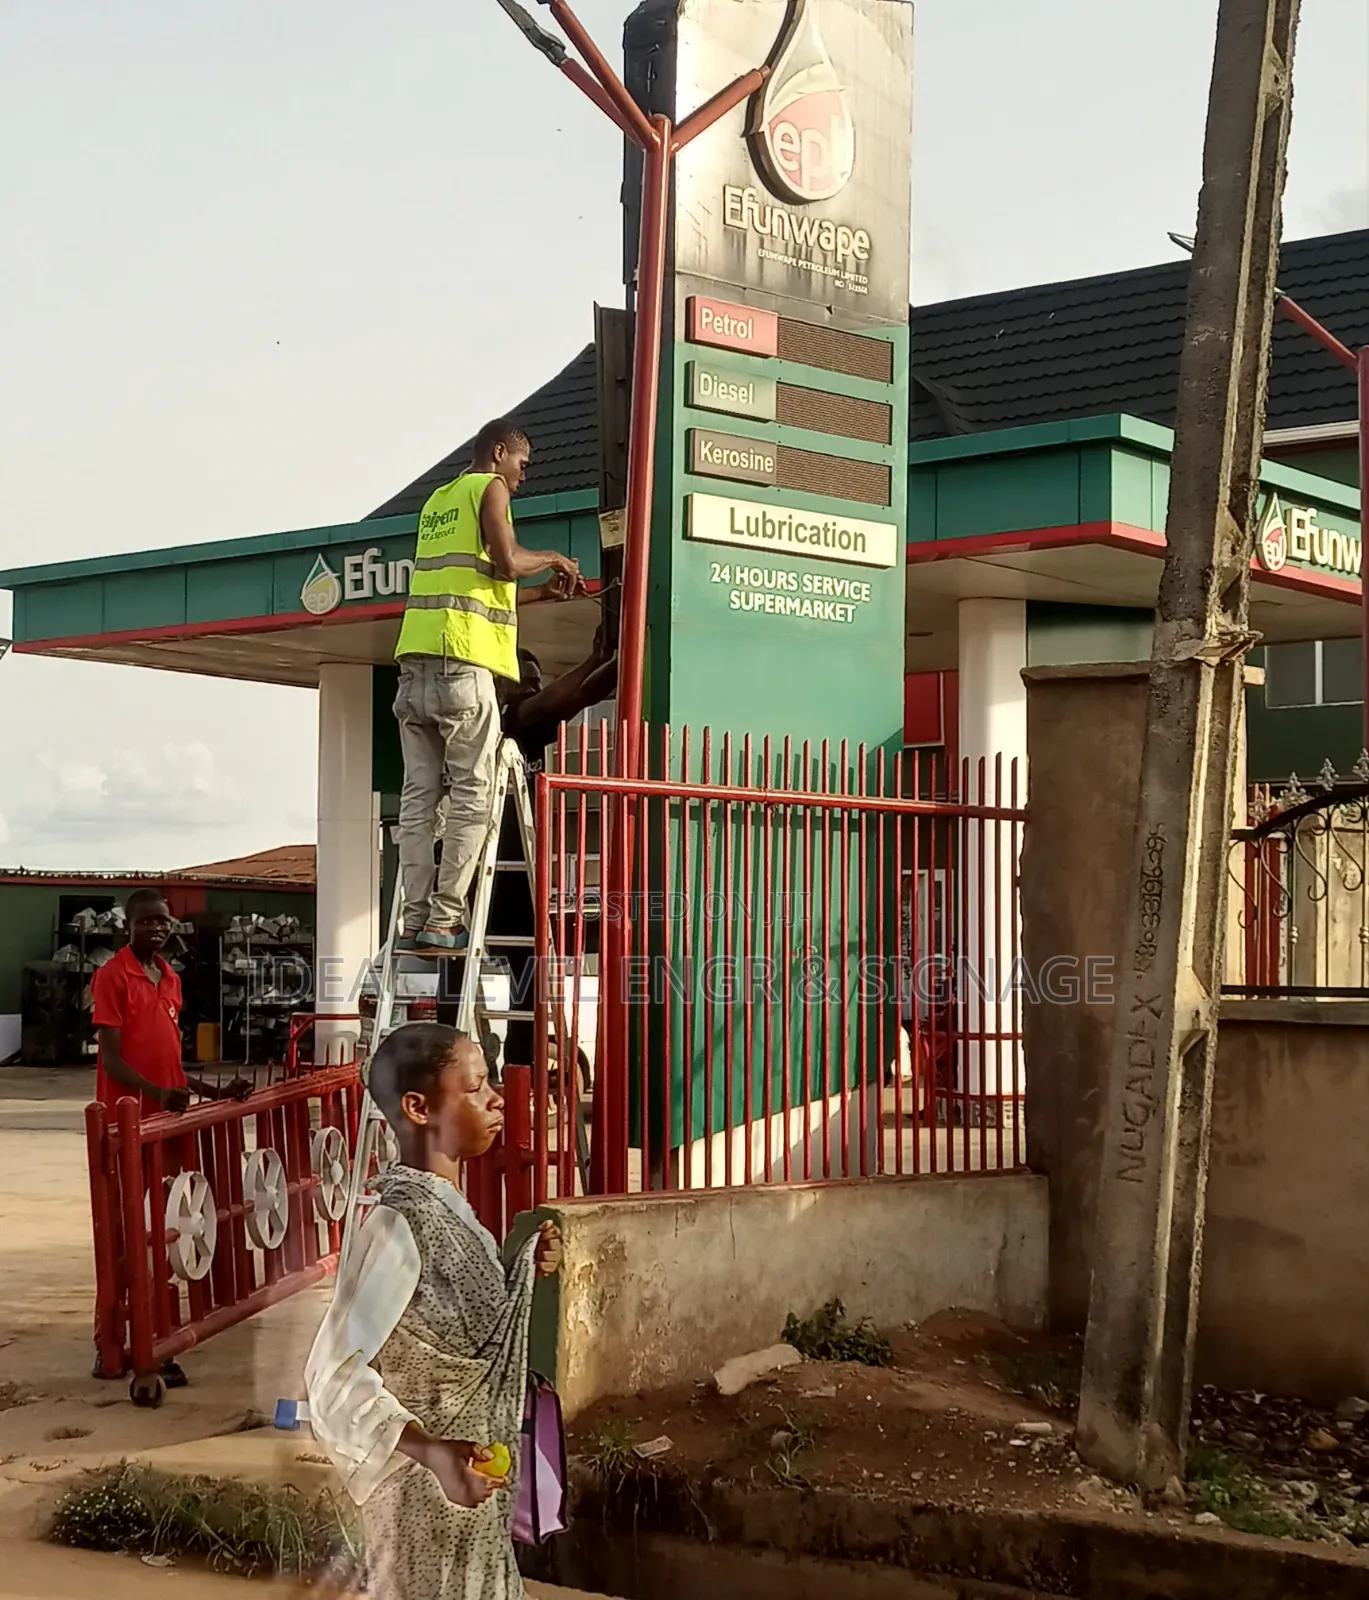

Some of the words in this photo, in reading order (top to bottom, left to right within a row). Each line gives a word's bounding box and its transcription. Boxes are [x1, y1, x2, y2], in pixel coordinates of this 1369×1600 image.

[724, 184, 870, 263] Efunwape
[757, 248, 797, 267] EFUNWAPE
[798, 258, 840, 277] PETROLEUM
[841, 270, 869, 284] LIMITED
[700, 306, 753, 341] Petrol
[699, 373, 754, 405] Diesel
[699, 440, 775, 473] Kerosine
[729, 506, 867, 553] Lubrication
[710, 562, 731, 585] 24
[735, 565, 798, 591] HOURS
[802, 574, 871, 602] SERVICE
[729, 590, 857, 623] SUPERMARKET
